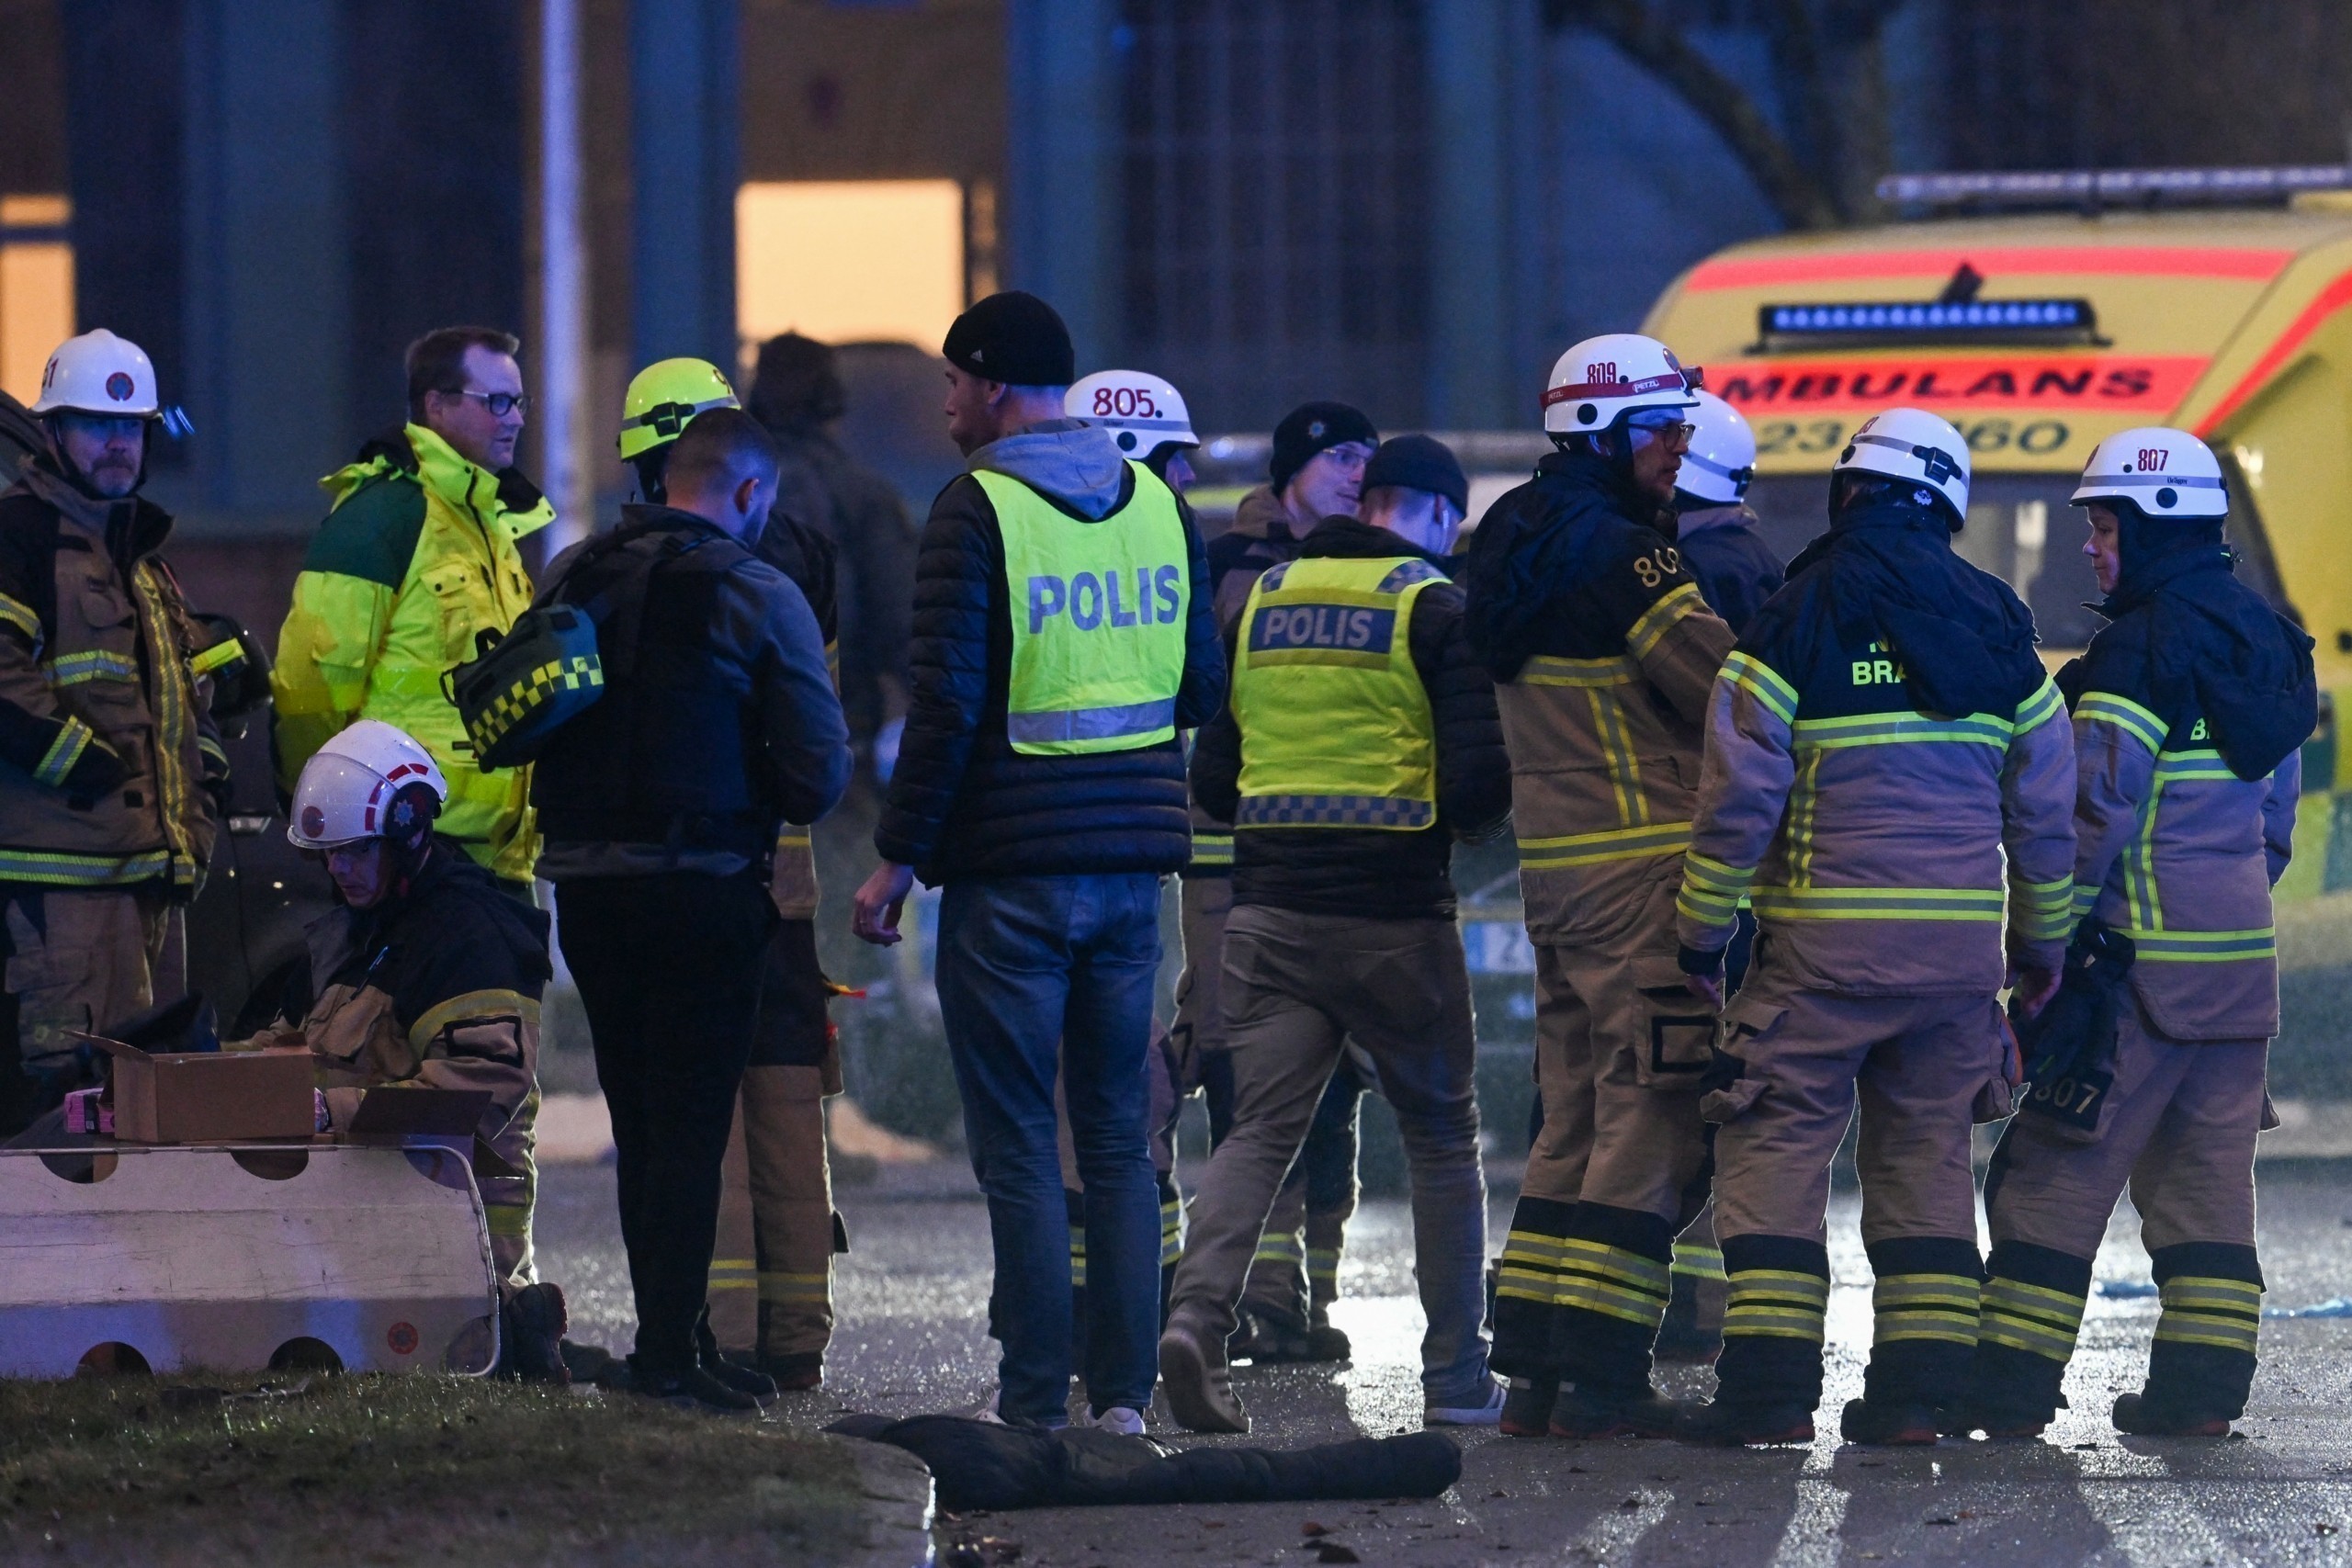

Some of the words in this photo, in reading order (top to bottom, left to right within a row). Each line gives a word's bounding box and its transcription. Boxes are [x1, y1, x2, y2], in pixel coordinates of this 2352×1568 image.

[1587, 362, 1617, 384] 809
[1634, 379, 1659, 393] PETZL
[1716, 369, 2153, 403] MBULANS
[1092, 388, 1155, 418] 805
[1951, 418, 2070, 455] 60
[2138, 448, 2168, 471] 807
[1027, 564, 1181, 634] POLIS
[1263, 607, 1374, 647] POLIS
